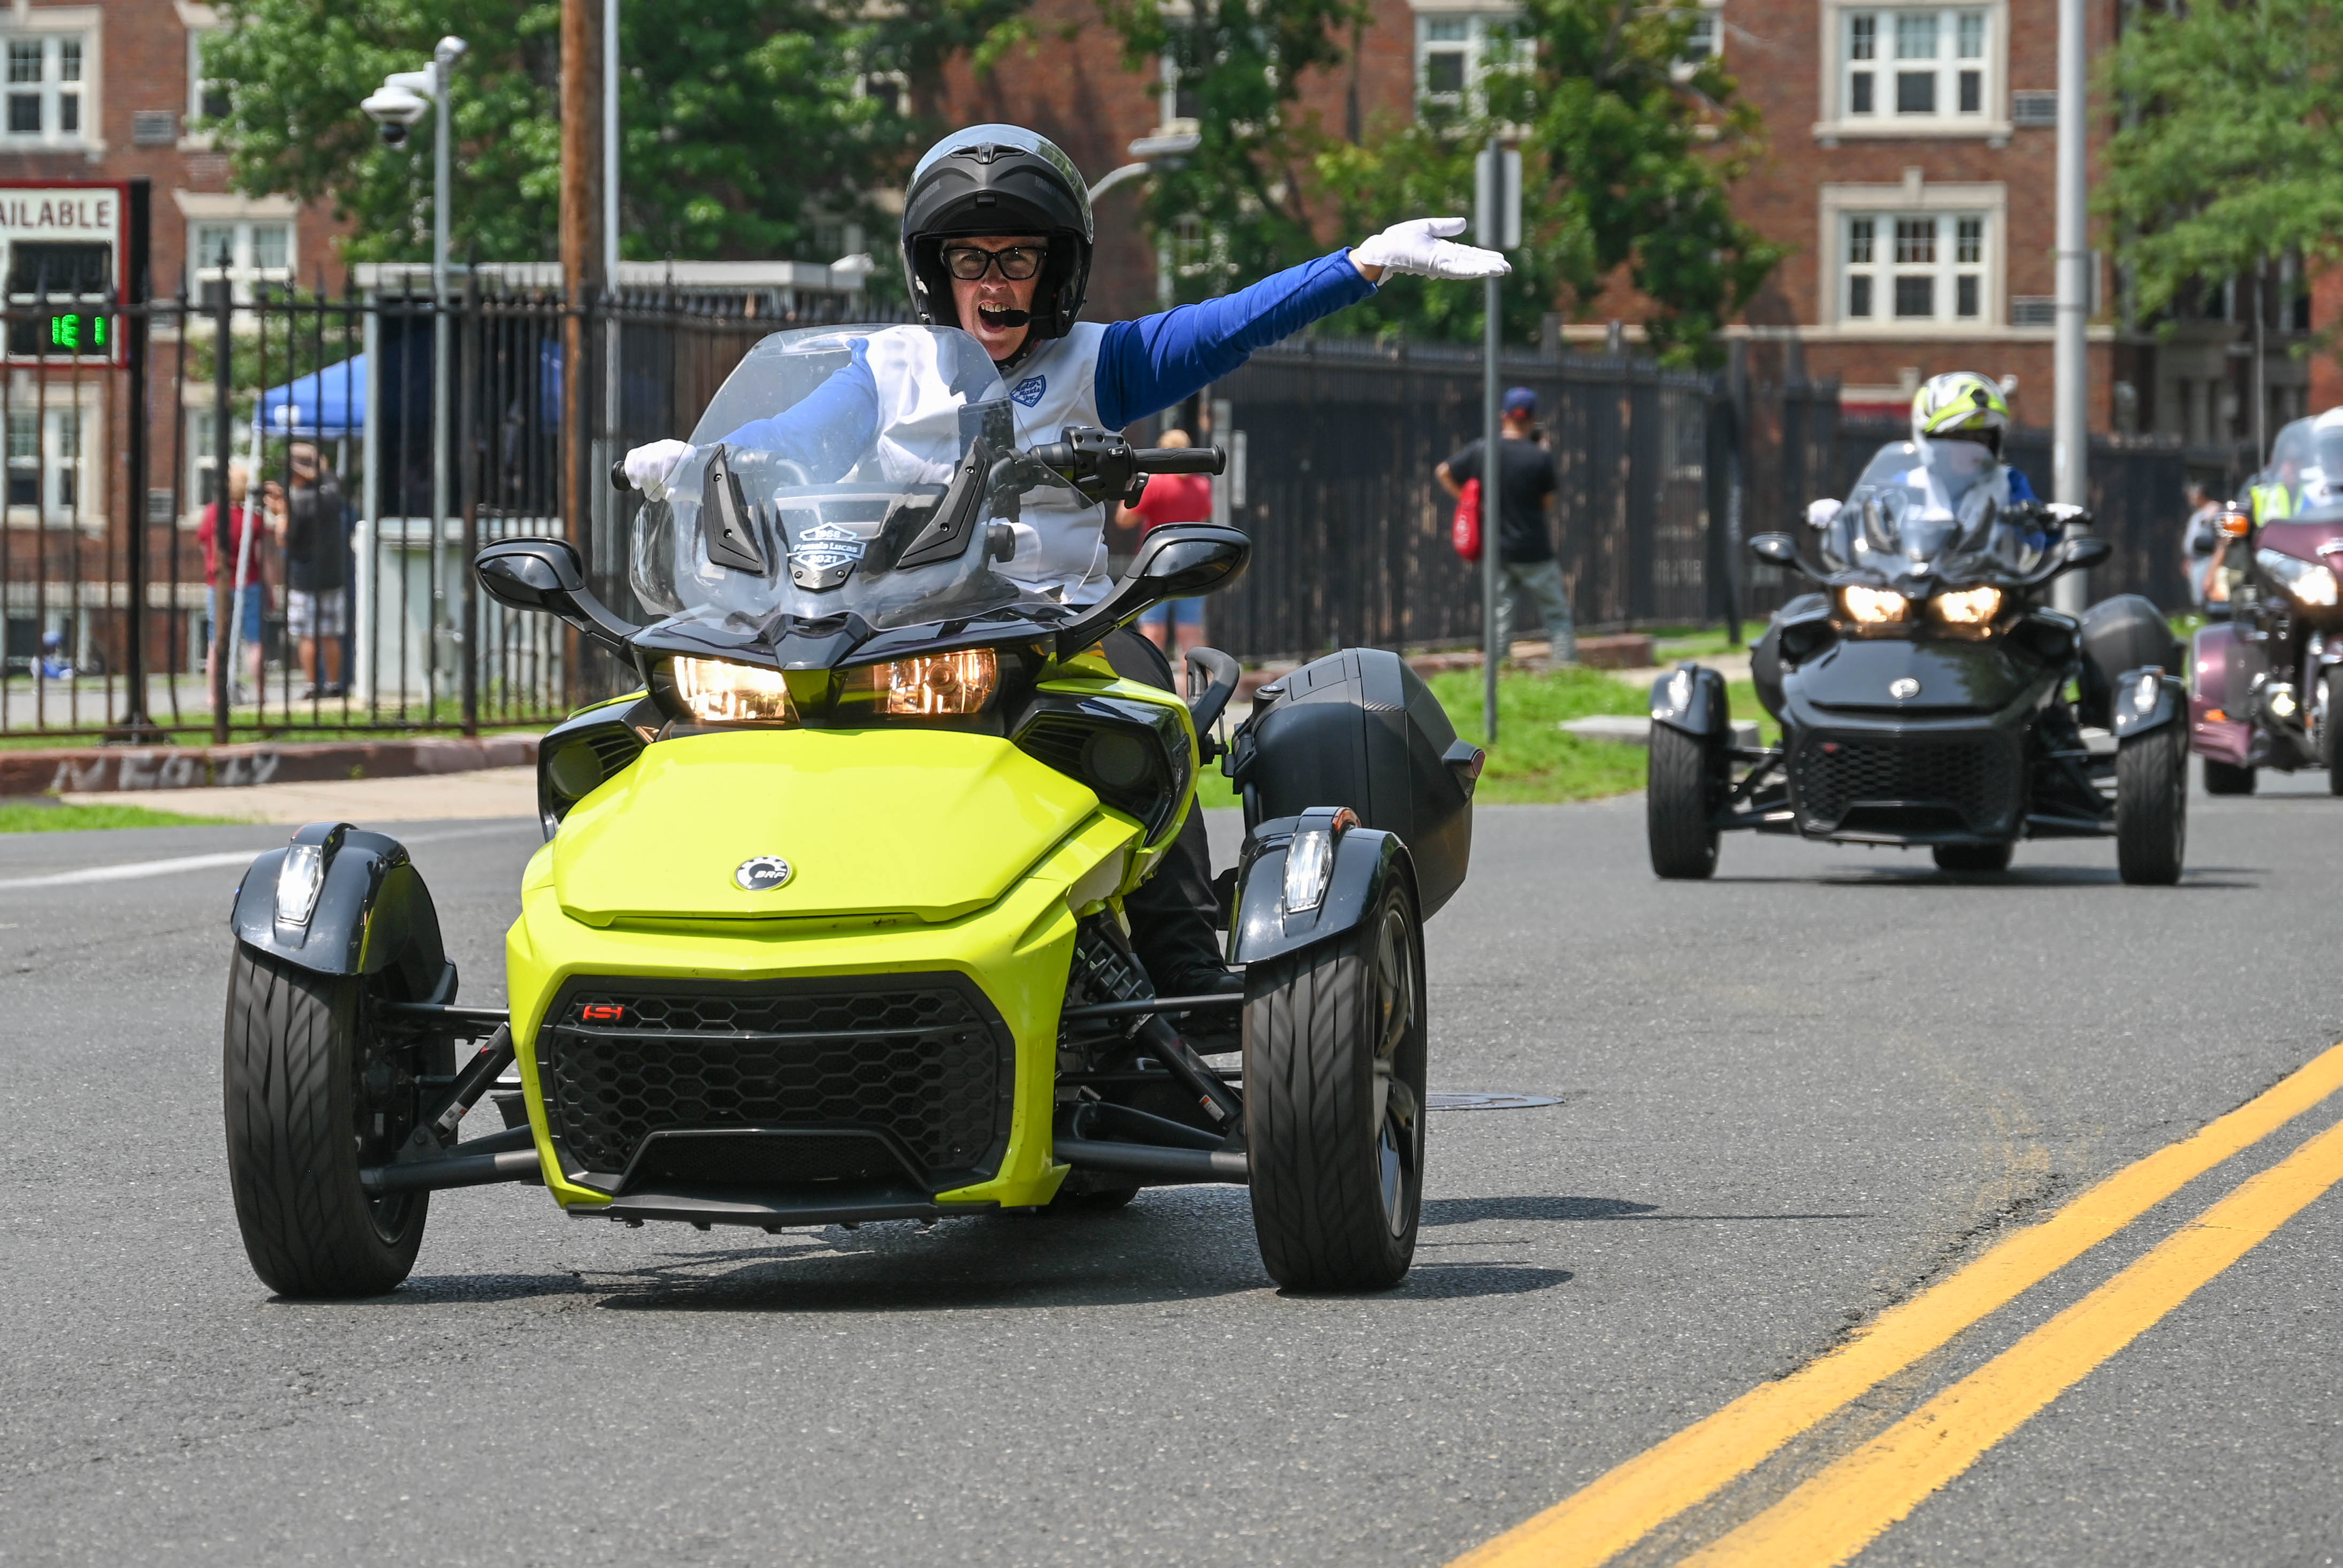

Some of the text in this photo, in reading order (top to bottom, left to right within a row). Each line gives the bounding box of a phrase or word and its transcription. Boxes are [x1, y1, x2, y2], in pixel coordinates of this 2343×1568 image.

[829, 542, 858, 553] Lucas
[809, 555, 837, 563] 2021
[754, 870, 786, 878] BRP
